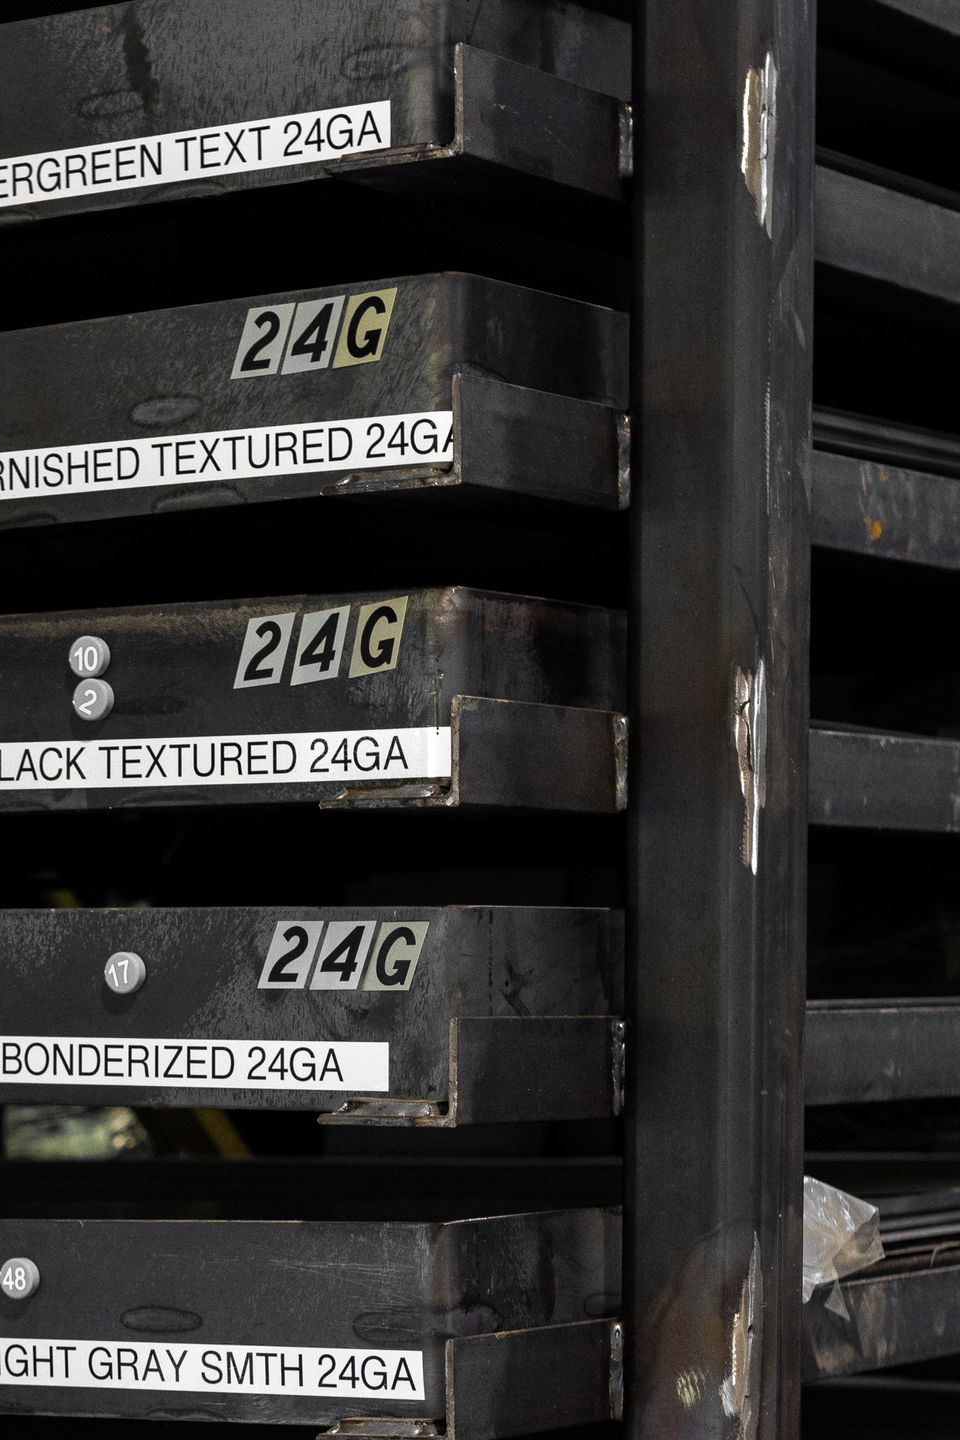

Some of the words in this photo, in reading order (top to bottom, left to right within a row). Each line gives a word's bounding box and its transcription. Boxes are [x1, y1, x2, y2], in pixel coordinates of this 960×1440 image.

[177, 127, 270, 170] TEXT
[283, 110, 381, 157] 24GA
[240, 296, 387, 372] 24G
[155, 428, 354, 477] TEXTURED
[73, 646, 98, 672] 10
[243, 605, 398, 681] 24G
[79, 689, 97, 716] 2
[99, 740, 297, 779] TEXTURED
[310, 735, 409, 774] 24GA
[107, 959, 130, 988] 17
[267, 925, 418, 986] 24G
[2, 1042, 235, 1079] BONDERIZED
[247, 1046, 344, 1083] 24GA
[1, 1267, 27, 1291] 48
[88, 1346, 188, 1383] GRAY
[200, 1351, 304, 1387] SMTH
[317, 1355, 417, 1392] 24GA
